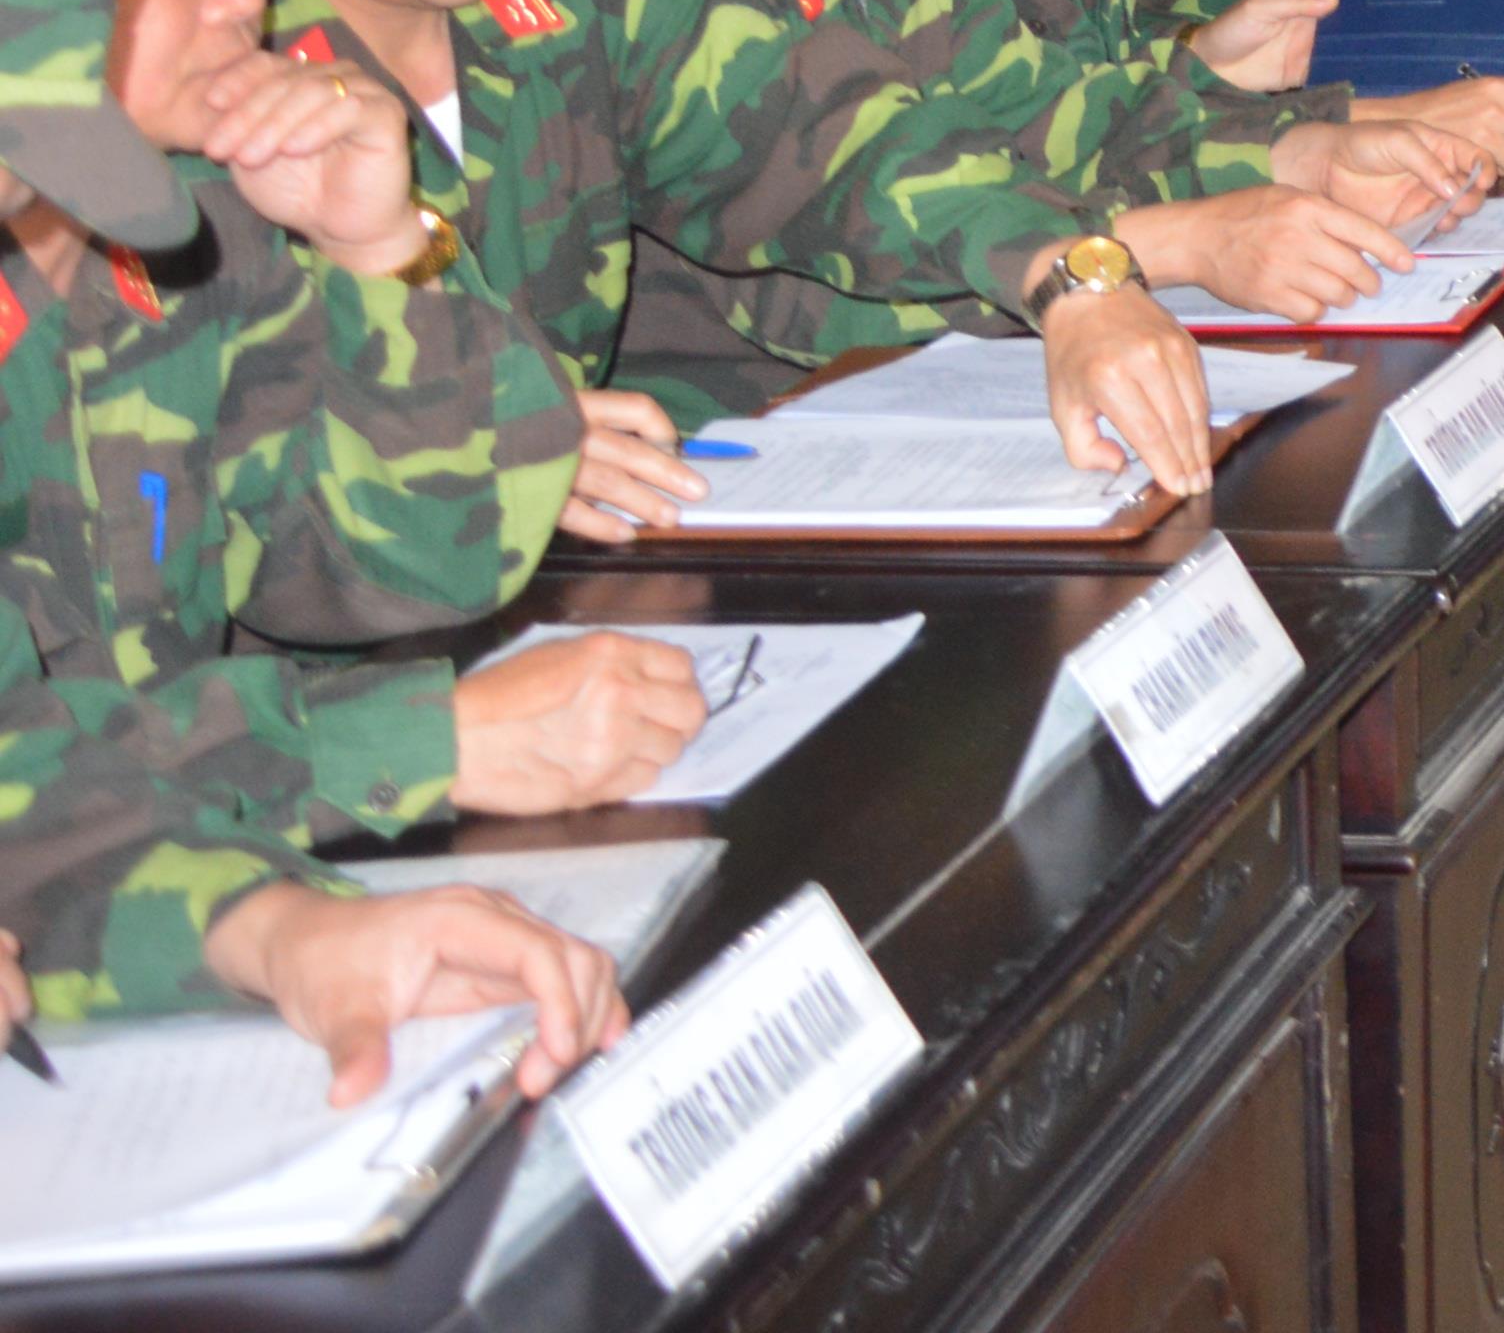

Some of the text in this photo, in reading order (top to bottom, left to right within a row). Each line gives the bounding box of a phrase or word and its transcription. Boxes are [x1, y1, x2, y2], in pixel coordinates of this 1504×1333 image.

[1424, 410, 1479, 482] TRƯỞNG
[1457, 400, 1497, 452] BAN
[1130, 600, 1260, 735] CHÁNH VĂN PHÒNG
[628, 965, 865, 1207] TRƯỞNG BAN DÂN QUÂN
